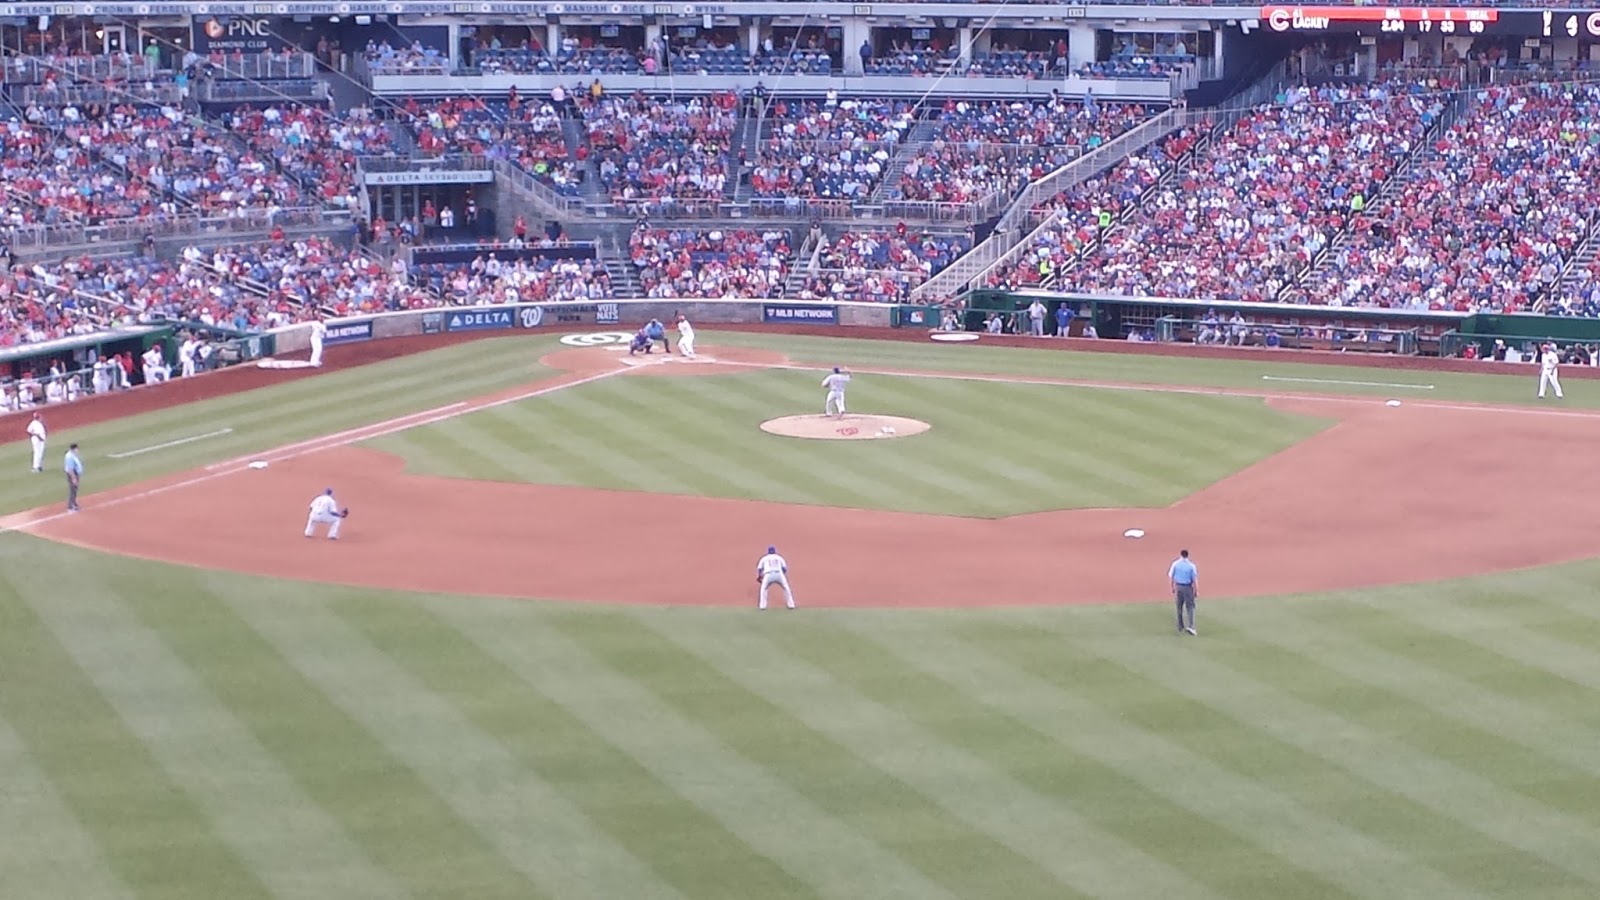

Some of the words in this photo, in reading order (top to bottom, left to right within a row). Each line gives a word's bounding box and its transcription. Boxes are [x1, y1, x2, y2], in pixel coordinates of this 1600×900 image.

[94, 5, 134, 13] CRONIN
[208, 5, 245, 13] GOSLIN
[287, 4, 334, 13] GRIFFITH
[349, 4, 387, 12] HARRIS
[622, 5, 645, 13] RICE
[228, 19, 270, 36] PNC
[1293, 17, 1329, 29] LACKEY
[1419, 20, 1431, 32] 17
[386, 174, 420, 182] DELTA
[543, 304, 598, 314] NATIONALS
[597, 304, 618, 312] VOTE
[596, 311, 619, 320] NATS
[775, 308, 793, 318] MLB
[794, 309, 834, 319] NETWORK
[465, 312, 509, 325] DELTA
[340, 325, 370, 337] NETWORK
